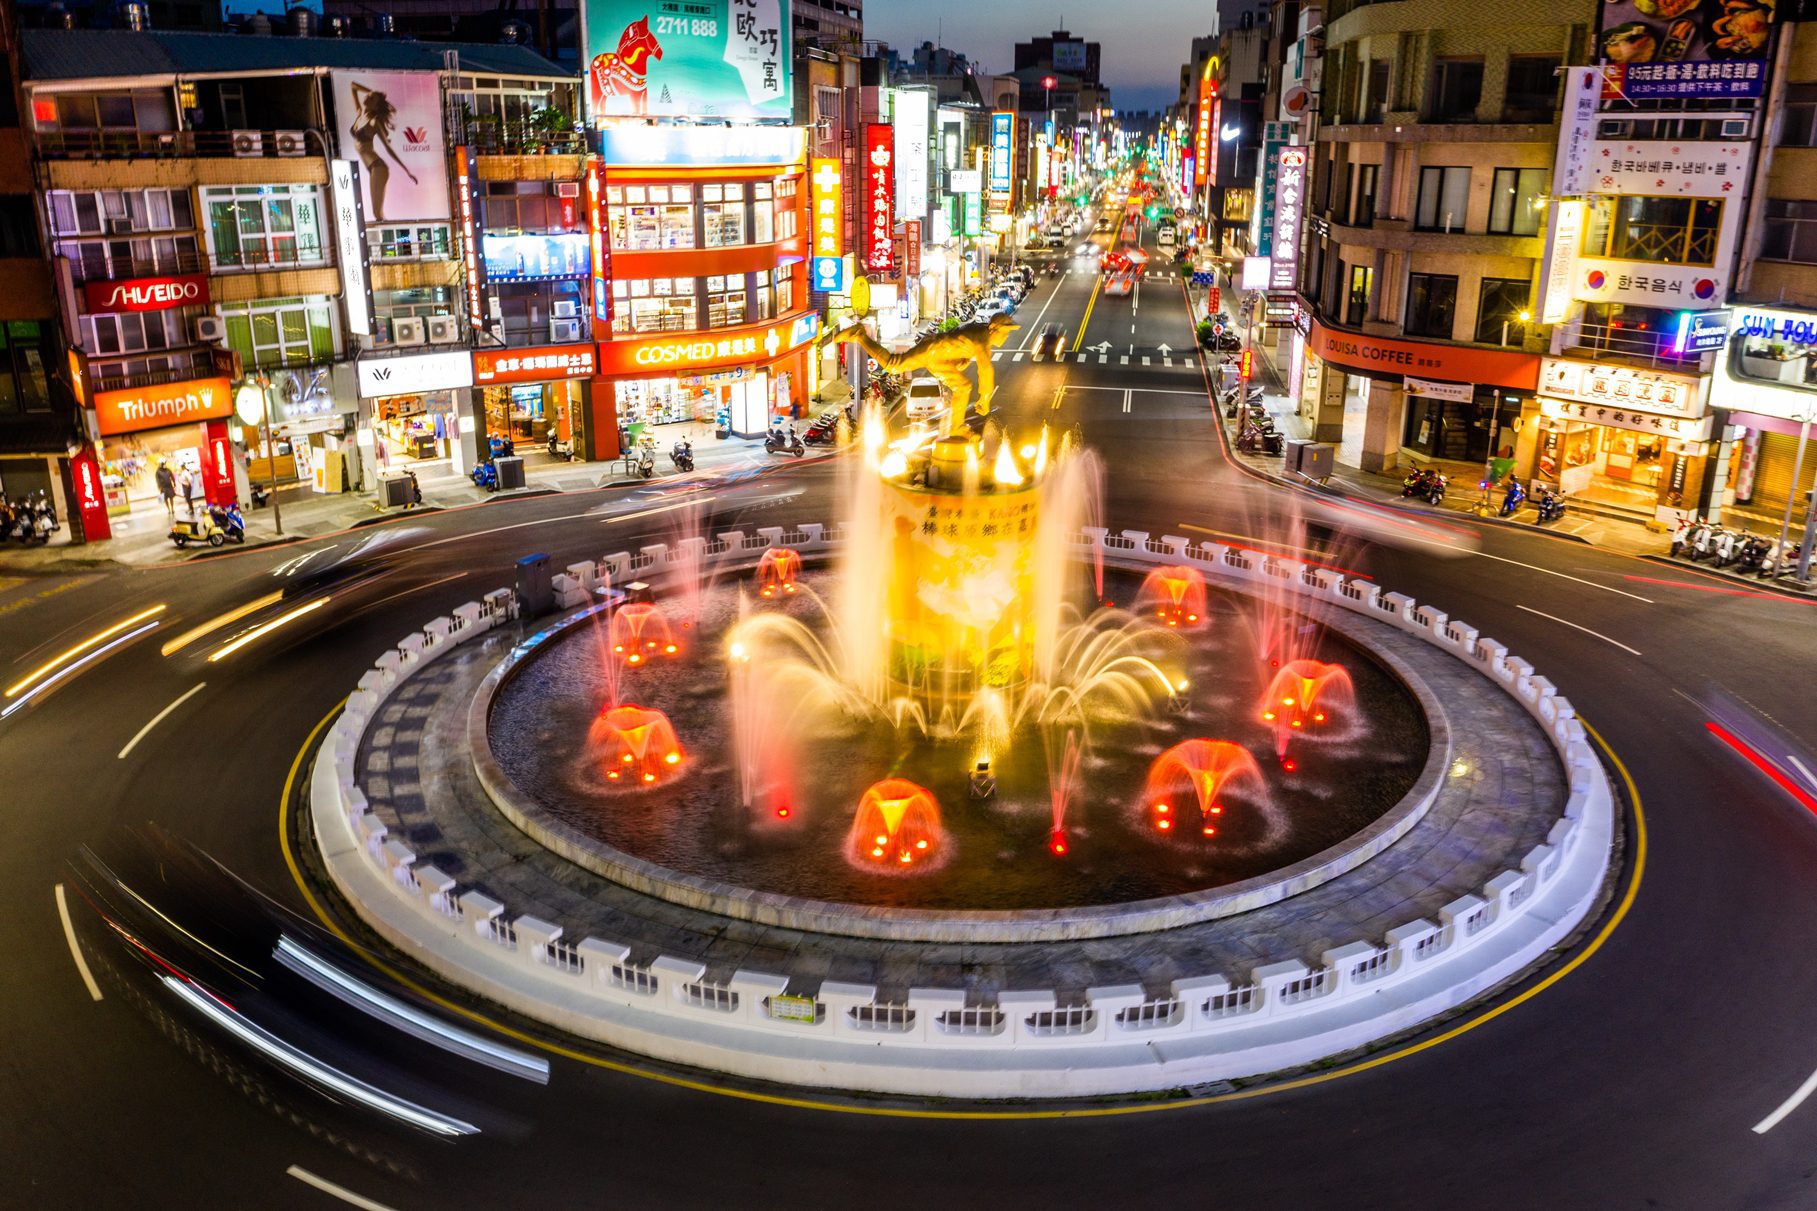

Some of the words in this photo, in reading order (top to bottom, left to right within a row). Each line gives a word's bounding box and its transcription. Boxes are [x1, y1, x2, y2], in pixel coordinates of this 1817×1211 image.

[657, 16, 688, 35] 2711
[691, 19, 717, 37] 888
[733, 0, 758, 42] 欧
[760, 29, 777, 91] 巧寓
[102, 281, 199, 307] SHISEIDO
[1618, 275, 1683, 295] 한국음식
[1738, 315, 1775, 338] SUN
[636, 342, 715, 365] COSMED
[717, 336, 756, 358] 康是美
[1326, 338, 1359, 357] LOUISA
[1362, 346, 1414, 365] COFFEE
[118, 394, 199, 421] Triumph
